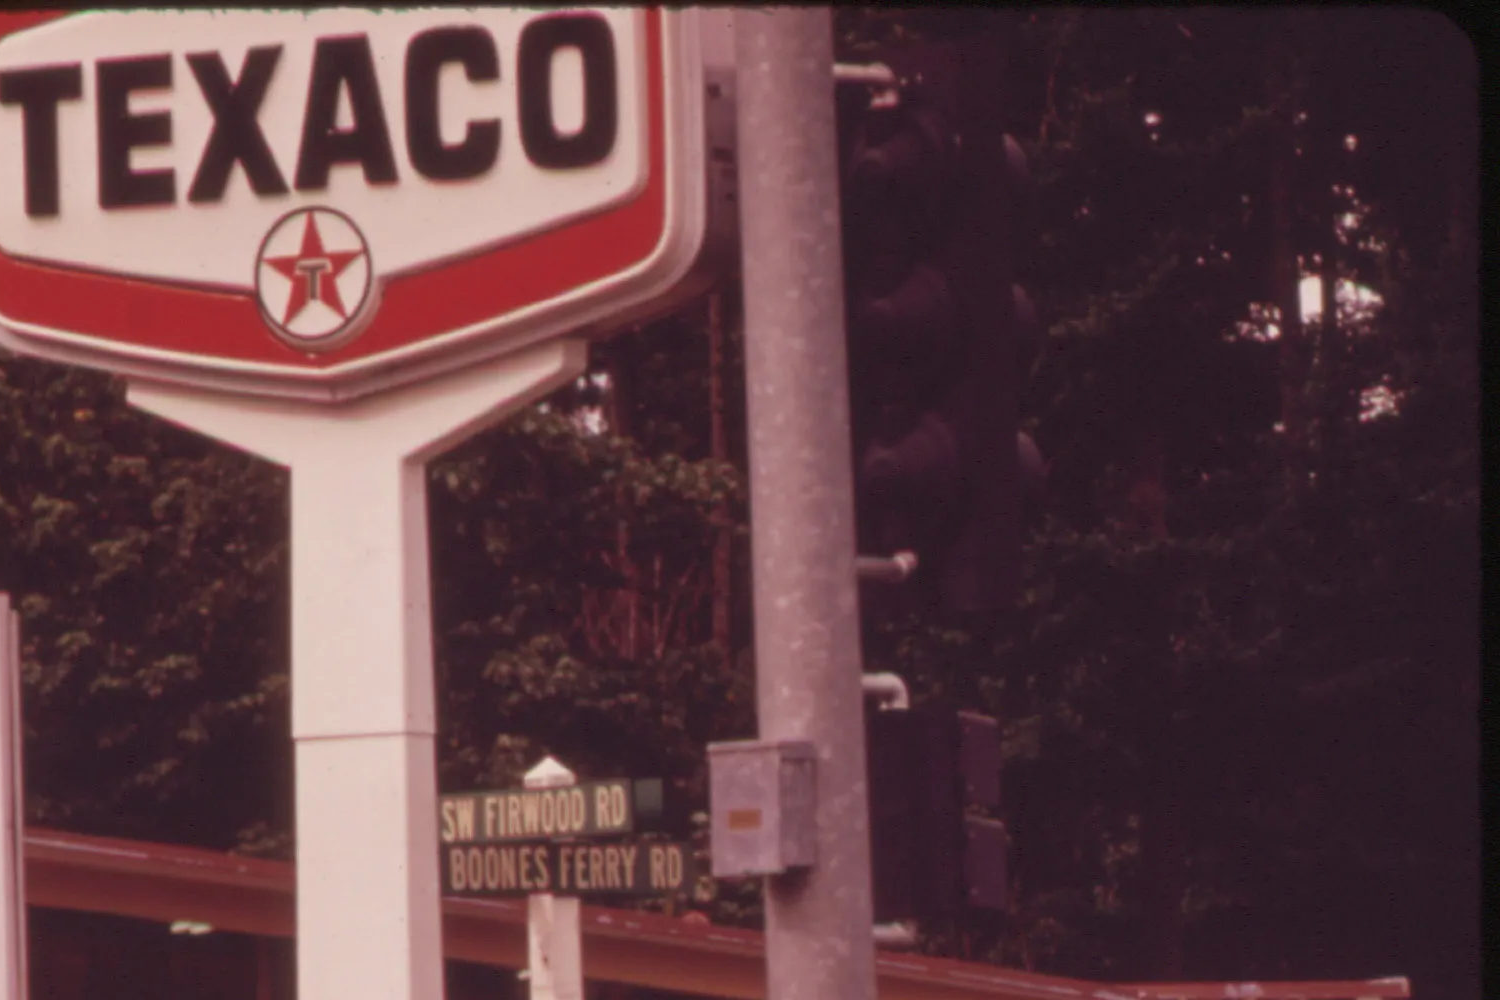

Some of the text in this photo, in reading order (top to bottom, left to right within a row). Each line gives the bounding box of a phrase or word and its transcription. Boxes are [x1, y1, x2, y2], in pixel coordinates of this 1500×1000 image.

[296, 259, 333, 301] T
[441, 784, 626, 842] SW FIRWOOD RD
[450, 844, 683, 891] BOONES FERRY RD
